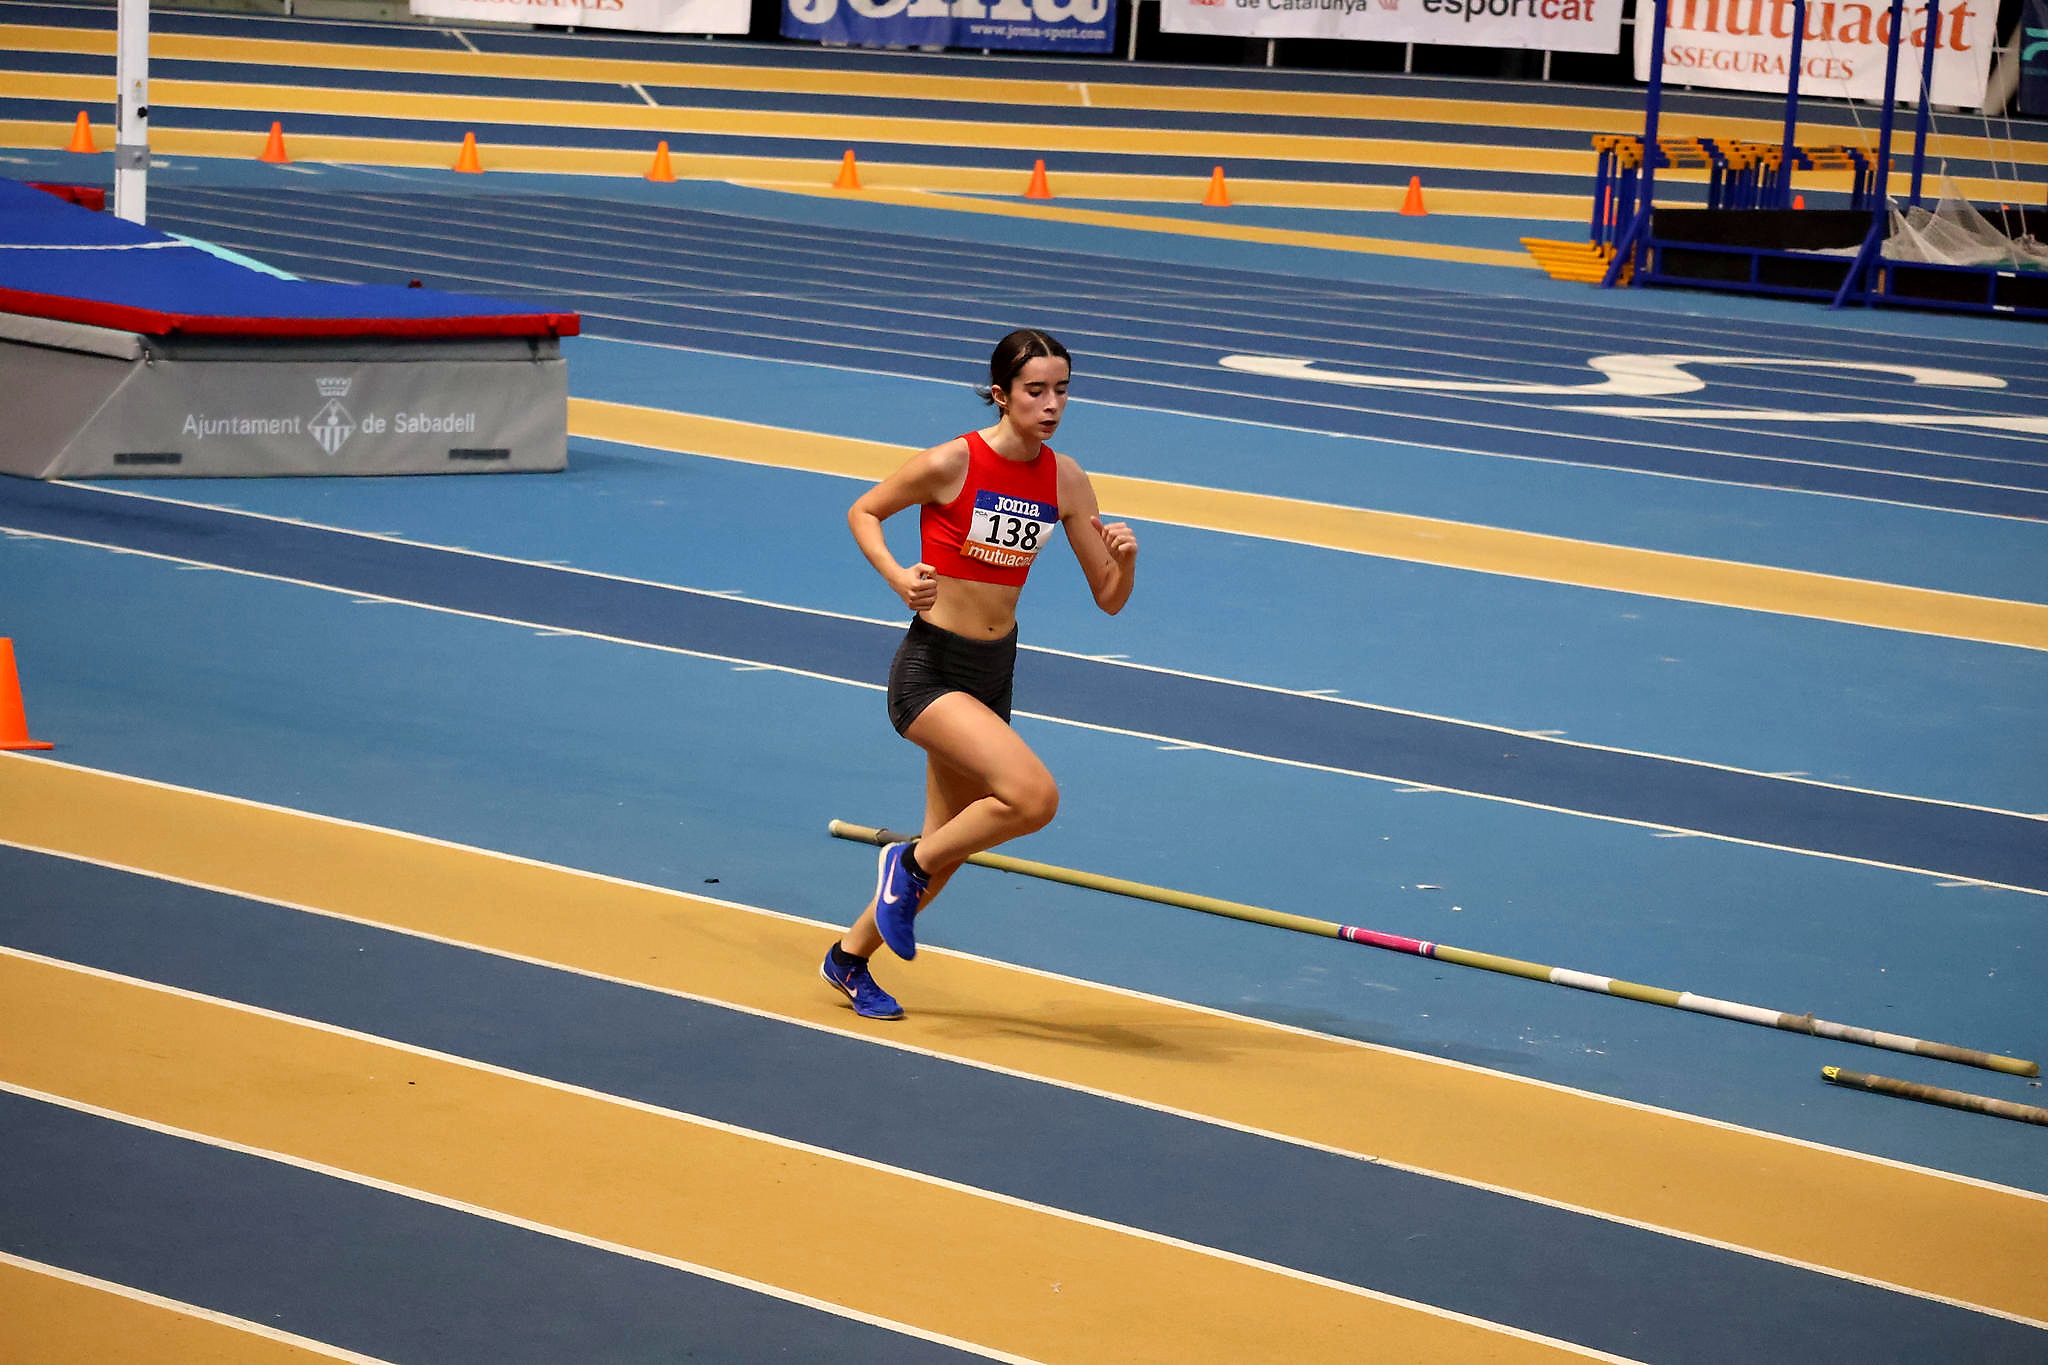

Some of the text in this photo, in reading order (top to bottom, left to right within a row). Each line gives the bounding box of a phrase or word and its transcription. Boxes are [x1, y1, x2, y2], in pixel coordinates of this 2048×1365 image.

[1268, 0, 1367, 15] Catalunya
[1423, 0, 1595, 22] esportcat
[970, 24, 1106, 41] www.joma-sport.com
[1661, 45, 1854, 80] SSEGURACES
[182, 412, 475, 438] Ajuntament de Sabadell
[985, 514, 1041, 551] 138
